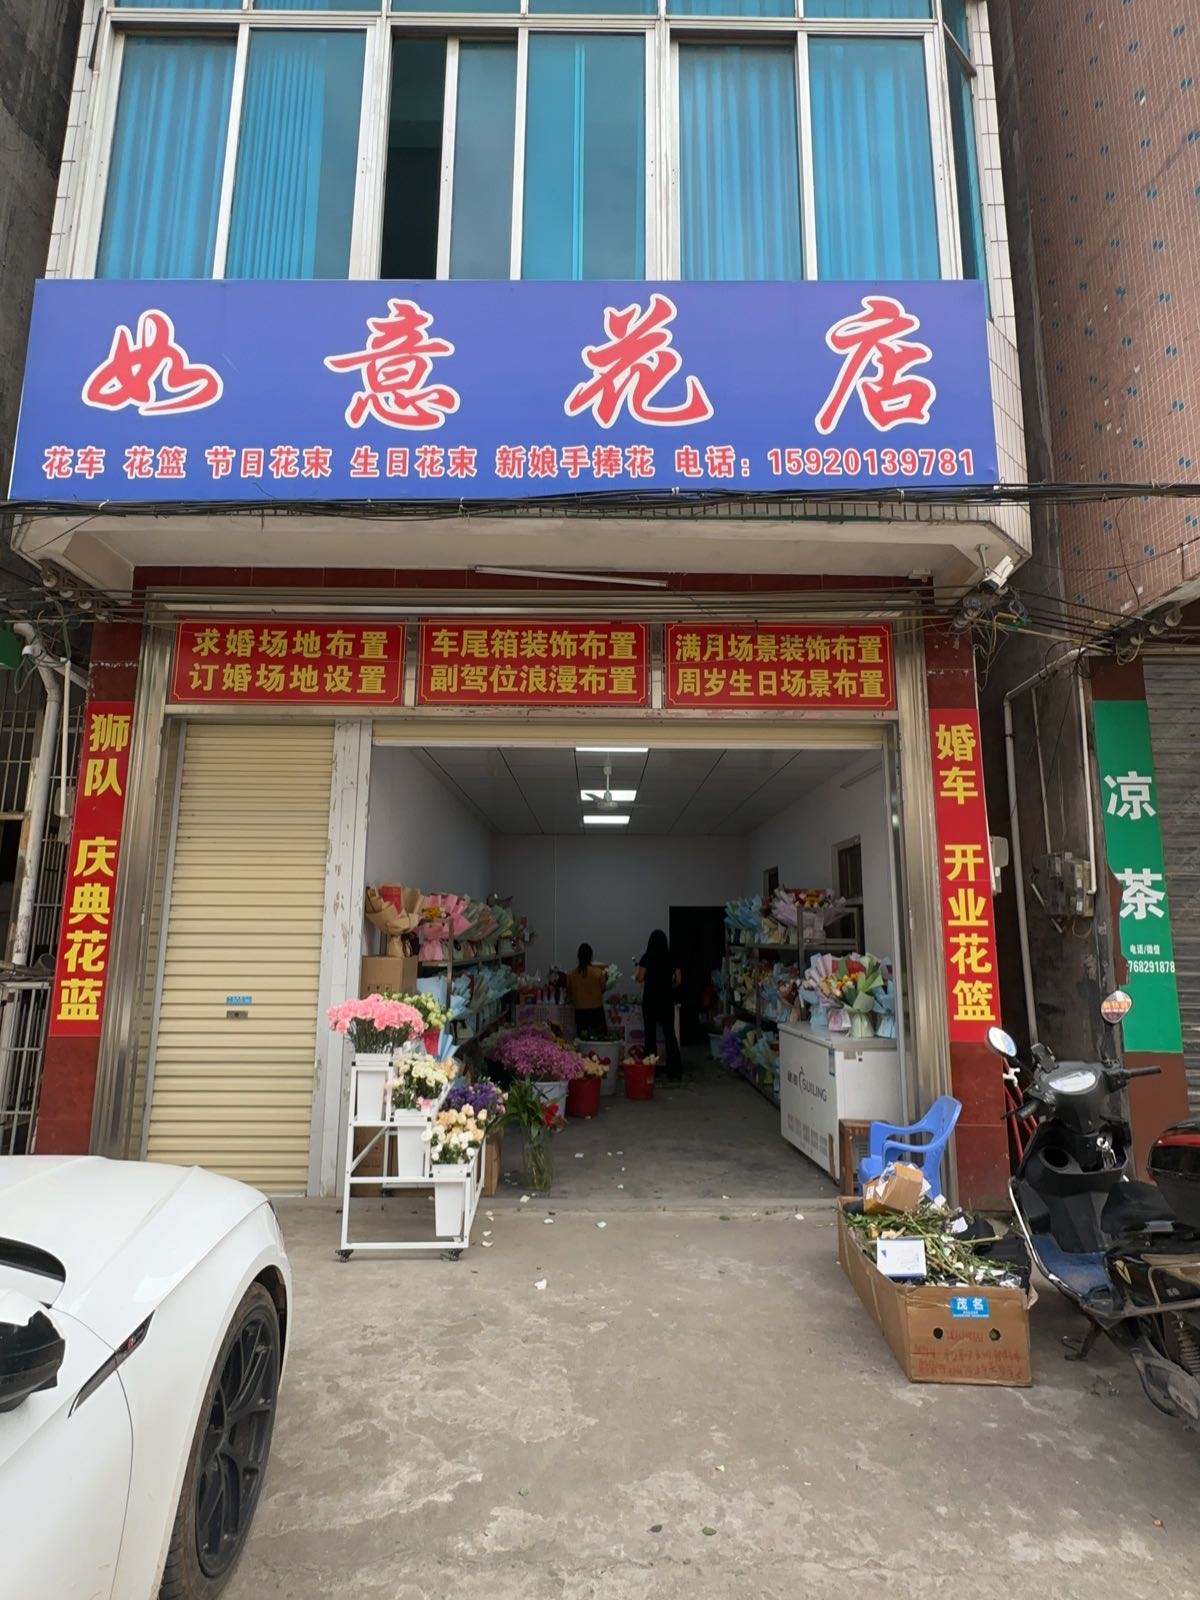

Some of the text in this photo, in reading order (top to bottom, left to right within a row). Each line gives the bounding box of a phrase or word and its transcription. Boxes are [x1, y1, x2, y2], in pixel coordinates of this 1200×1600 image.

[82, 293, 936, 432] 如意花店
[42, 446, 105, 479] 花车
[123, 446, 187, 479] 花篮
[205, 445, 332, 479] 节日花束
[350, 445, 477, 478] 生日花束
[495, 445, 655, 478] 新娘手捧花
[193, 628, 388, 659] 求婚场地布置
[432, 629, 637, 660] 车尾箱装饰布置
[675, 633, 884, 663] 满月场景装饰布置
[189, 663, 387, 694] 订婚场地设置
[430, 664, 637, 694] 副驾位浪漫布置
[676, 667, 886, 698] 周岁生日场景布置
[84, 713, 130, 797] 狮队
[1104, 771, 1165, 919] 凉茶
[936, 723, 996, 1021] 婚车 开业花篮
